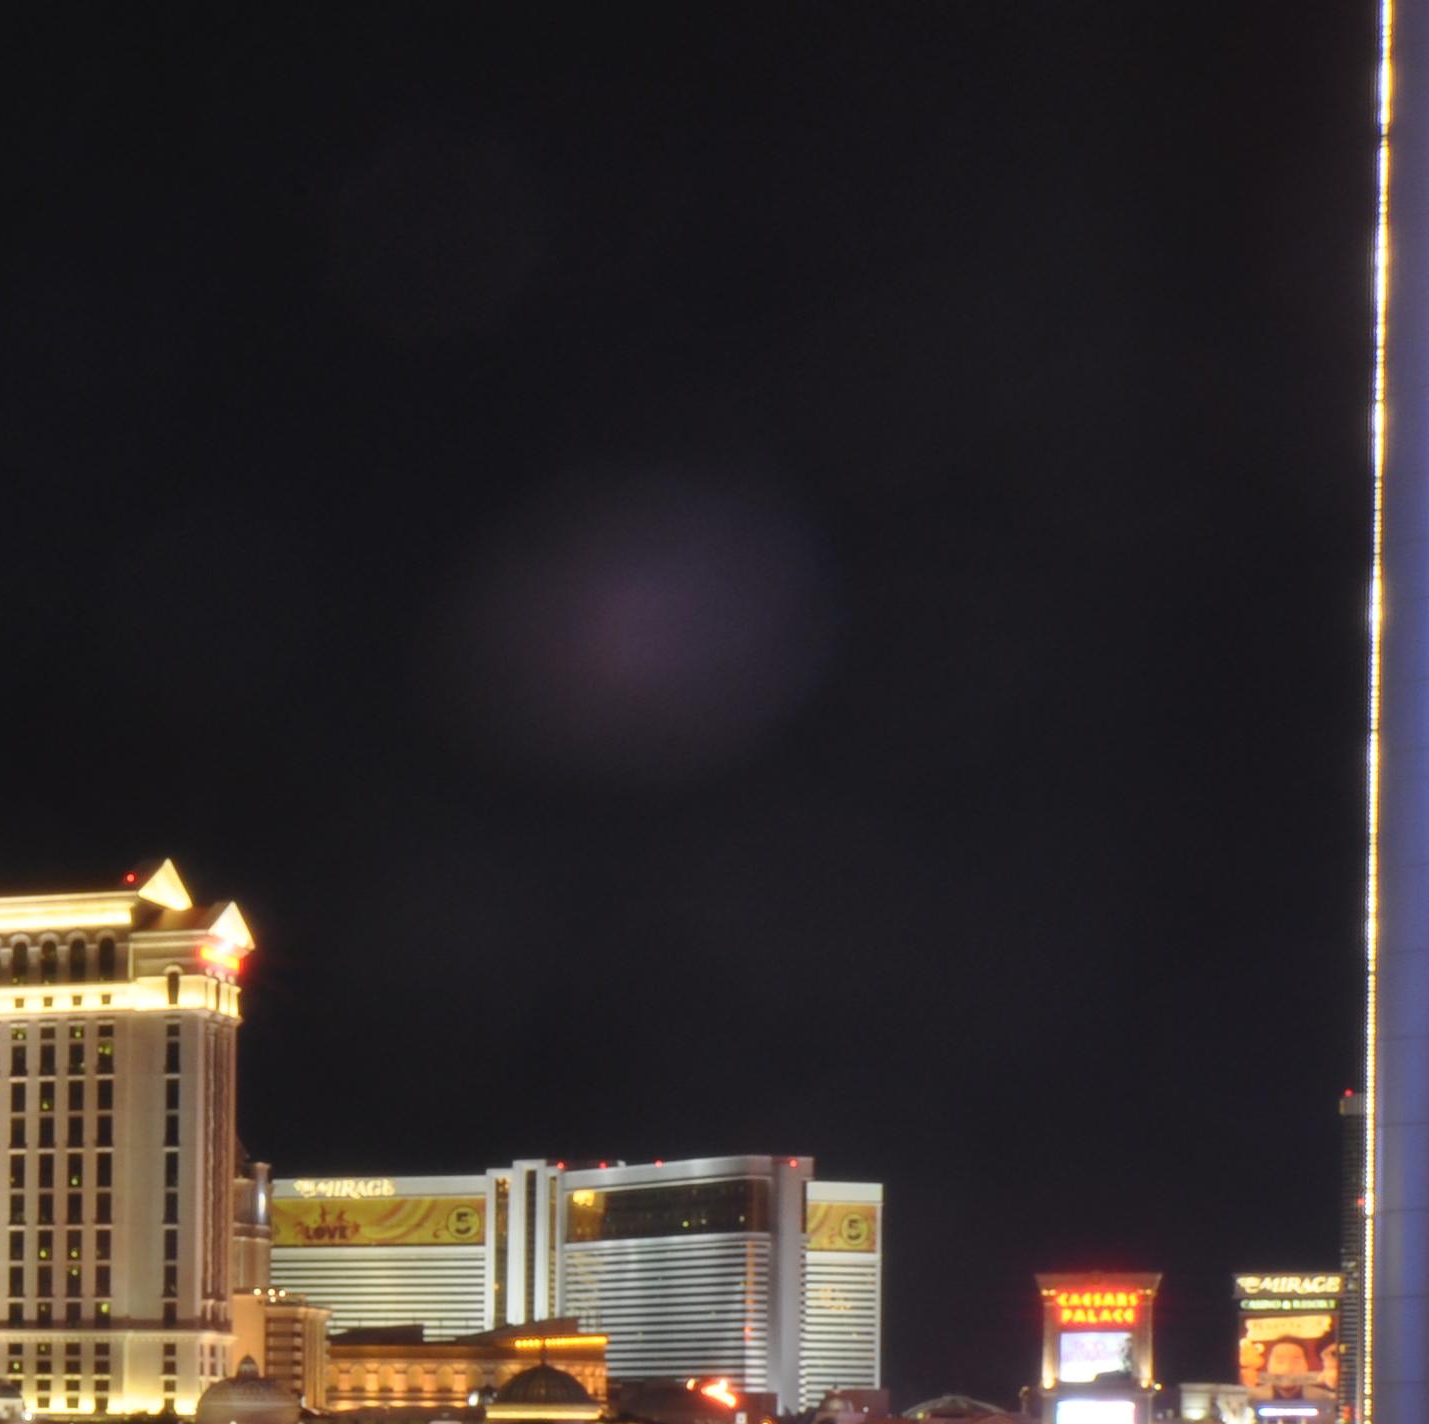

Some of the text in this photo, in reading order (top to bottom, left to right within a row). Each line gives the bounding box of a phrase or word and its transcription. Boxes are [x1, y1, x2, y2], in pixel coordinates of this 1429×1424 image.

[1260, 1276, 1341, 1294] MIRAGE
[1057, 1292, 1138, 1308] CAESARS
[1060, 1308, 1136, 1325] PALACE
